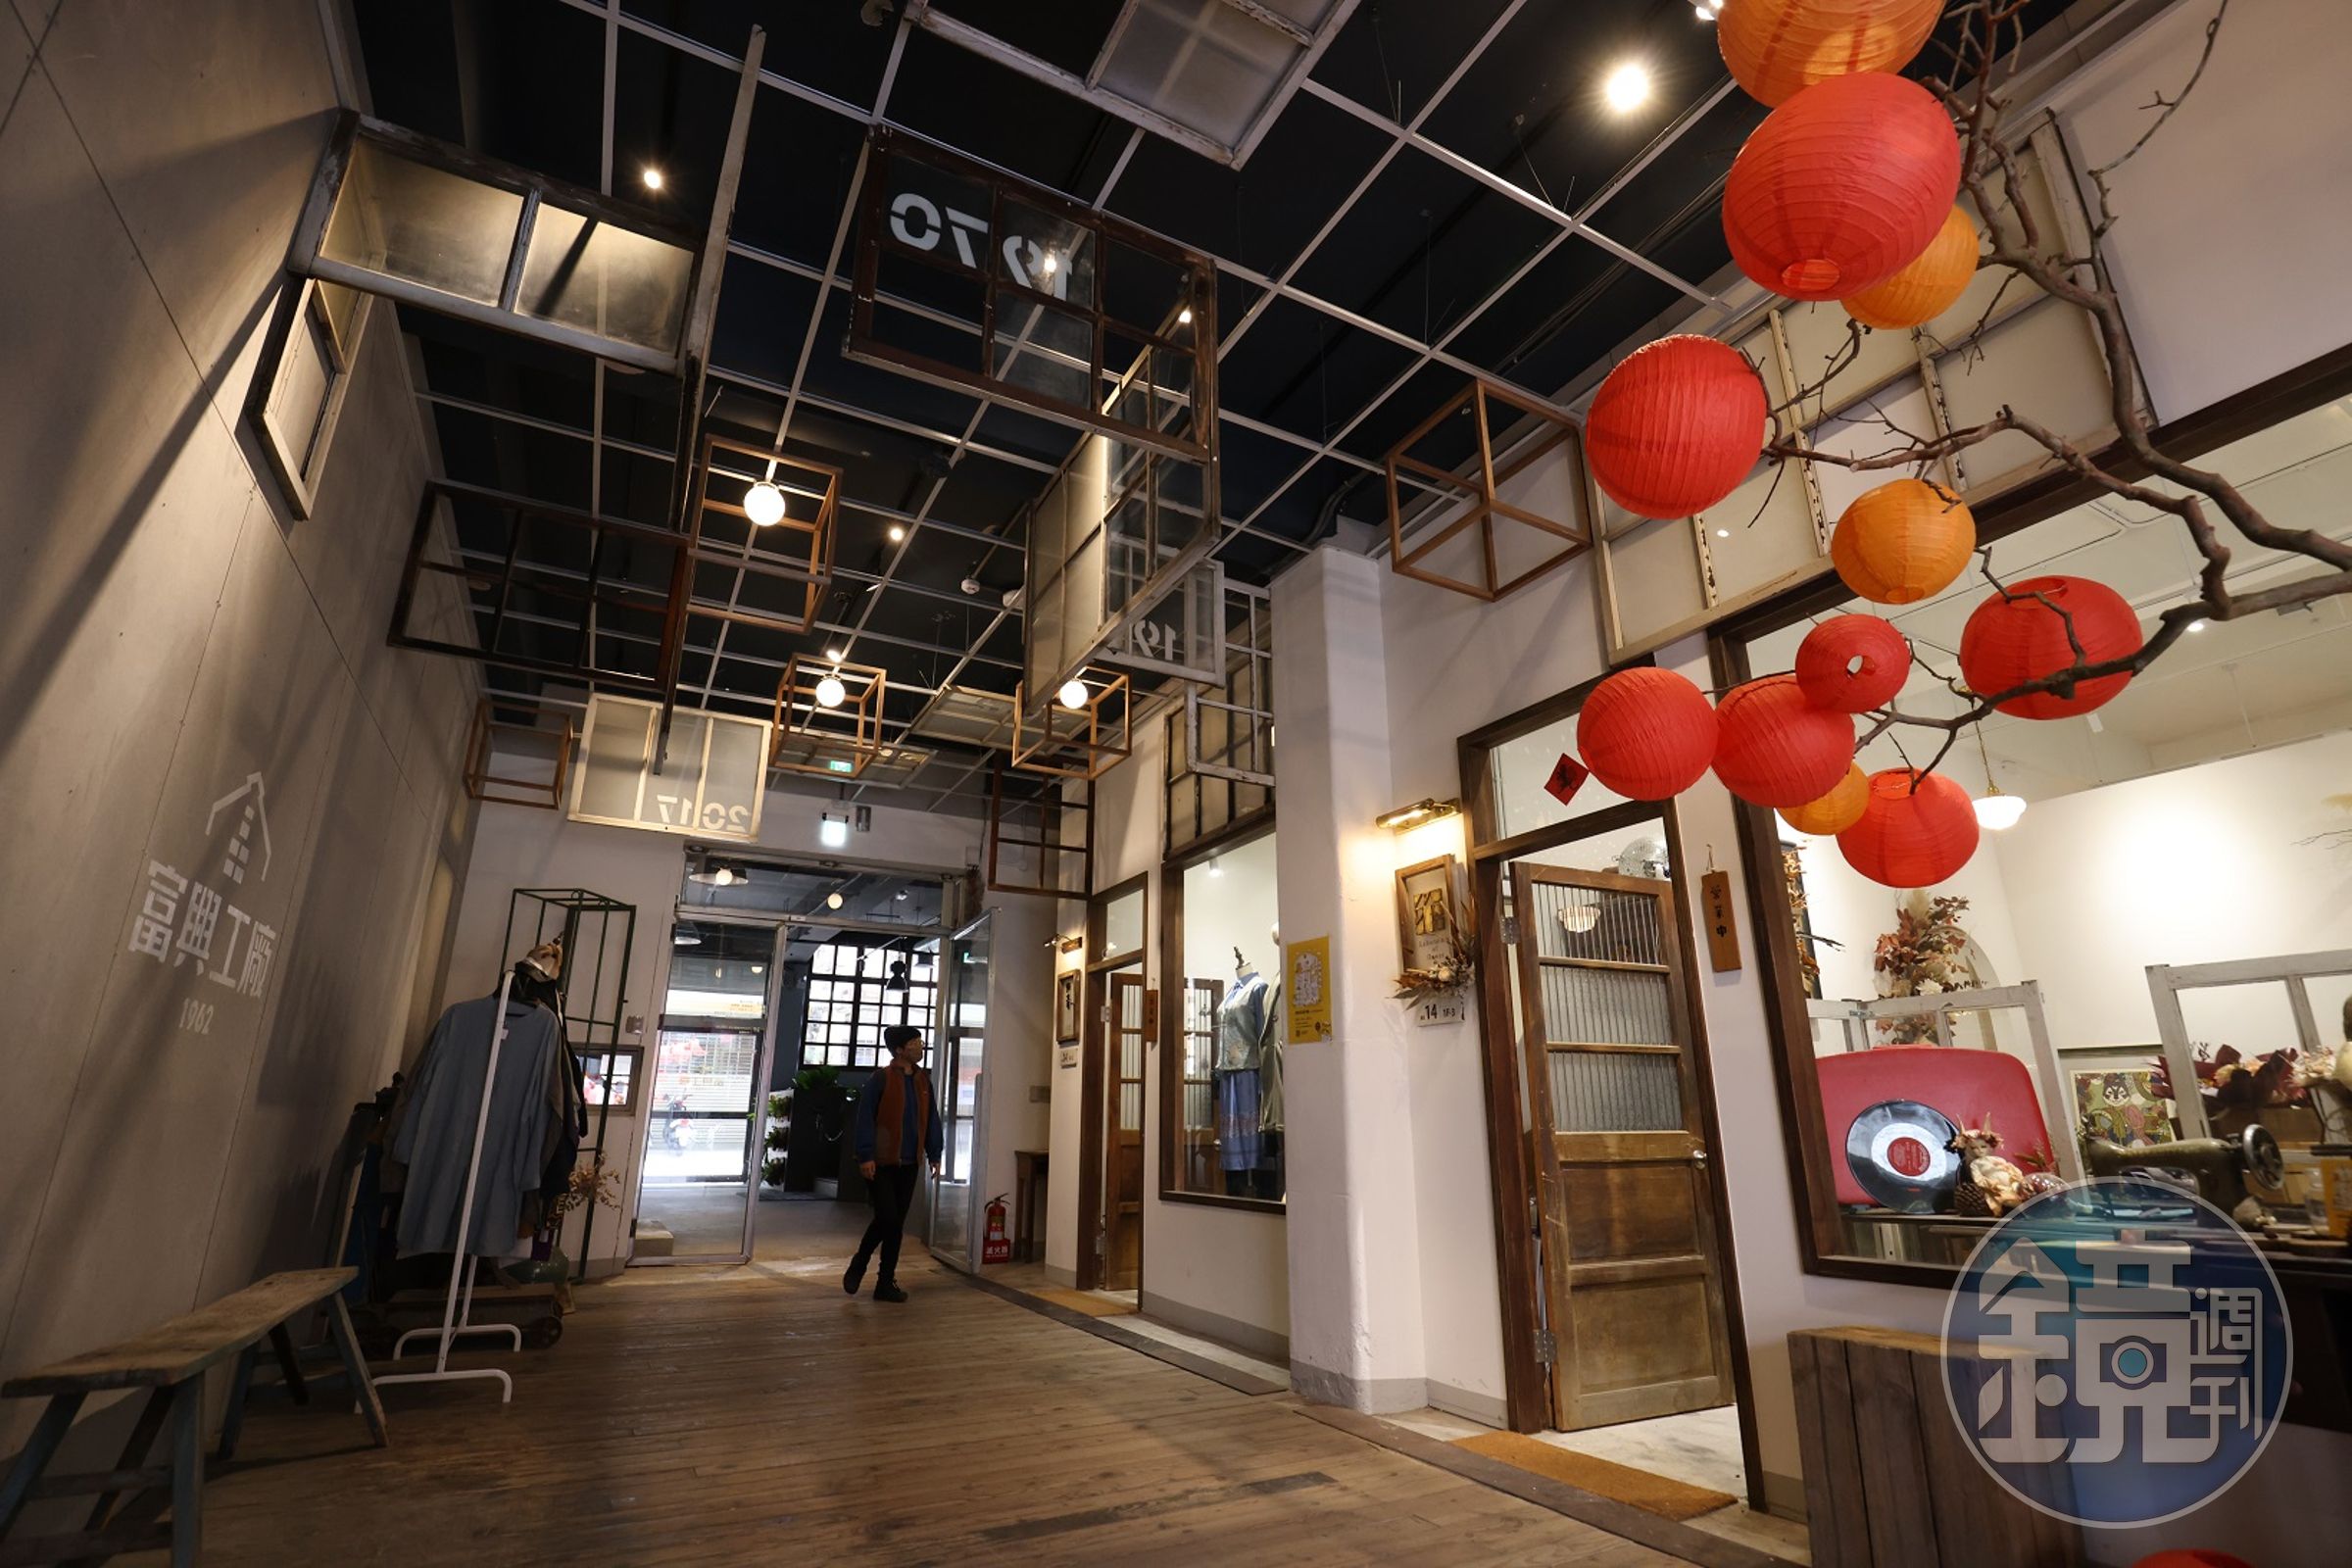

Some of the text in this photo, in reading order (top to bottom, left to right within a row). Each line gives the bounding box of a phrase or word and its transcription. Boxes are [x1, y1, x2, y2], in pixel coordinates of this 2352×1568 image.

[128, 859, 276, 999] 富興工廠
[178, 997, 215, 1035] 1962
[1425, 1004, 1438, 1020] 14
